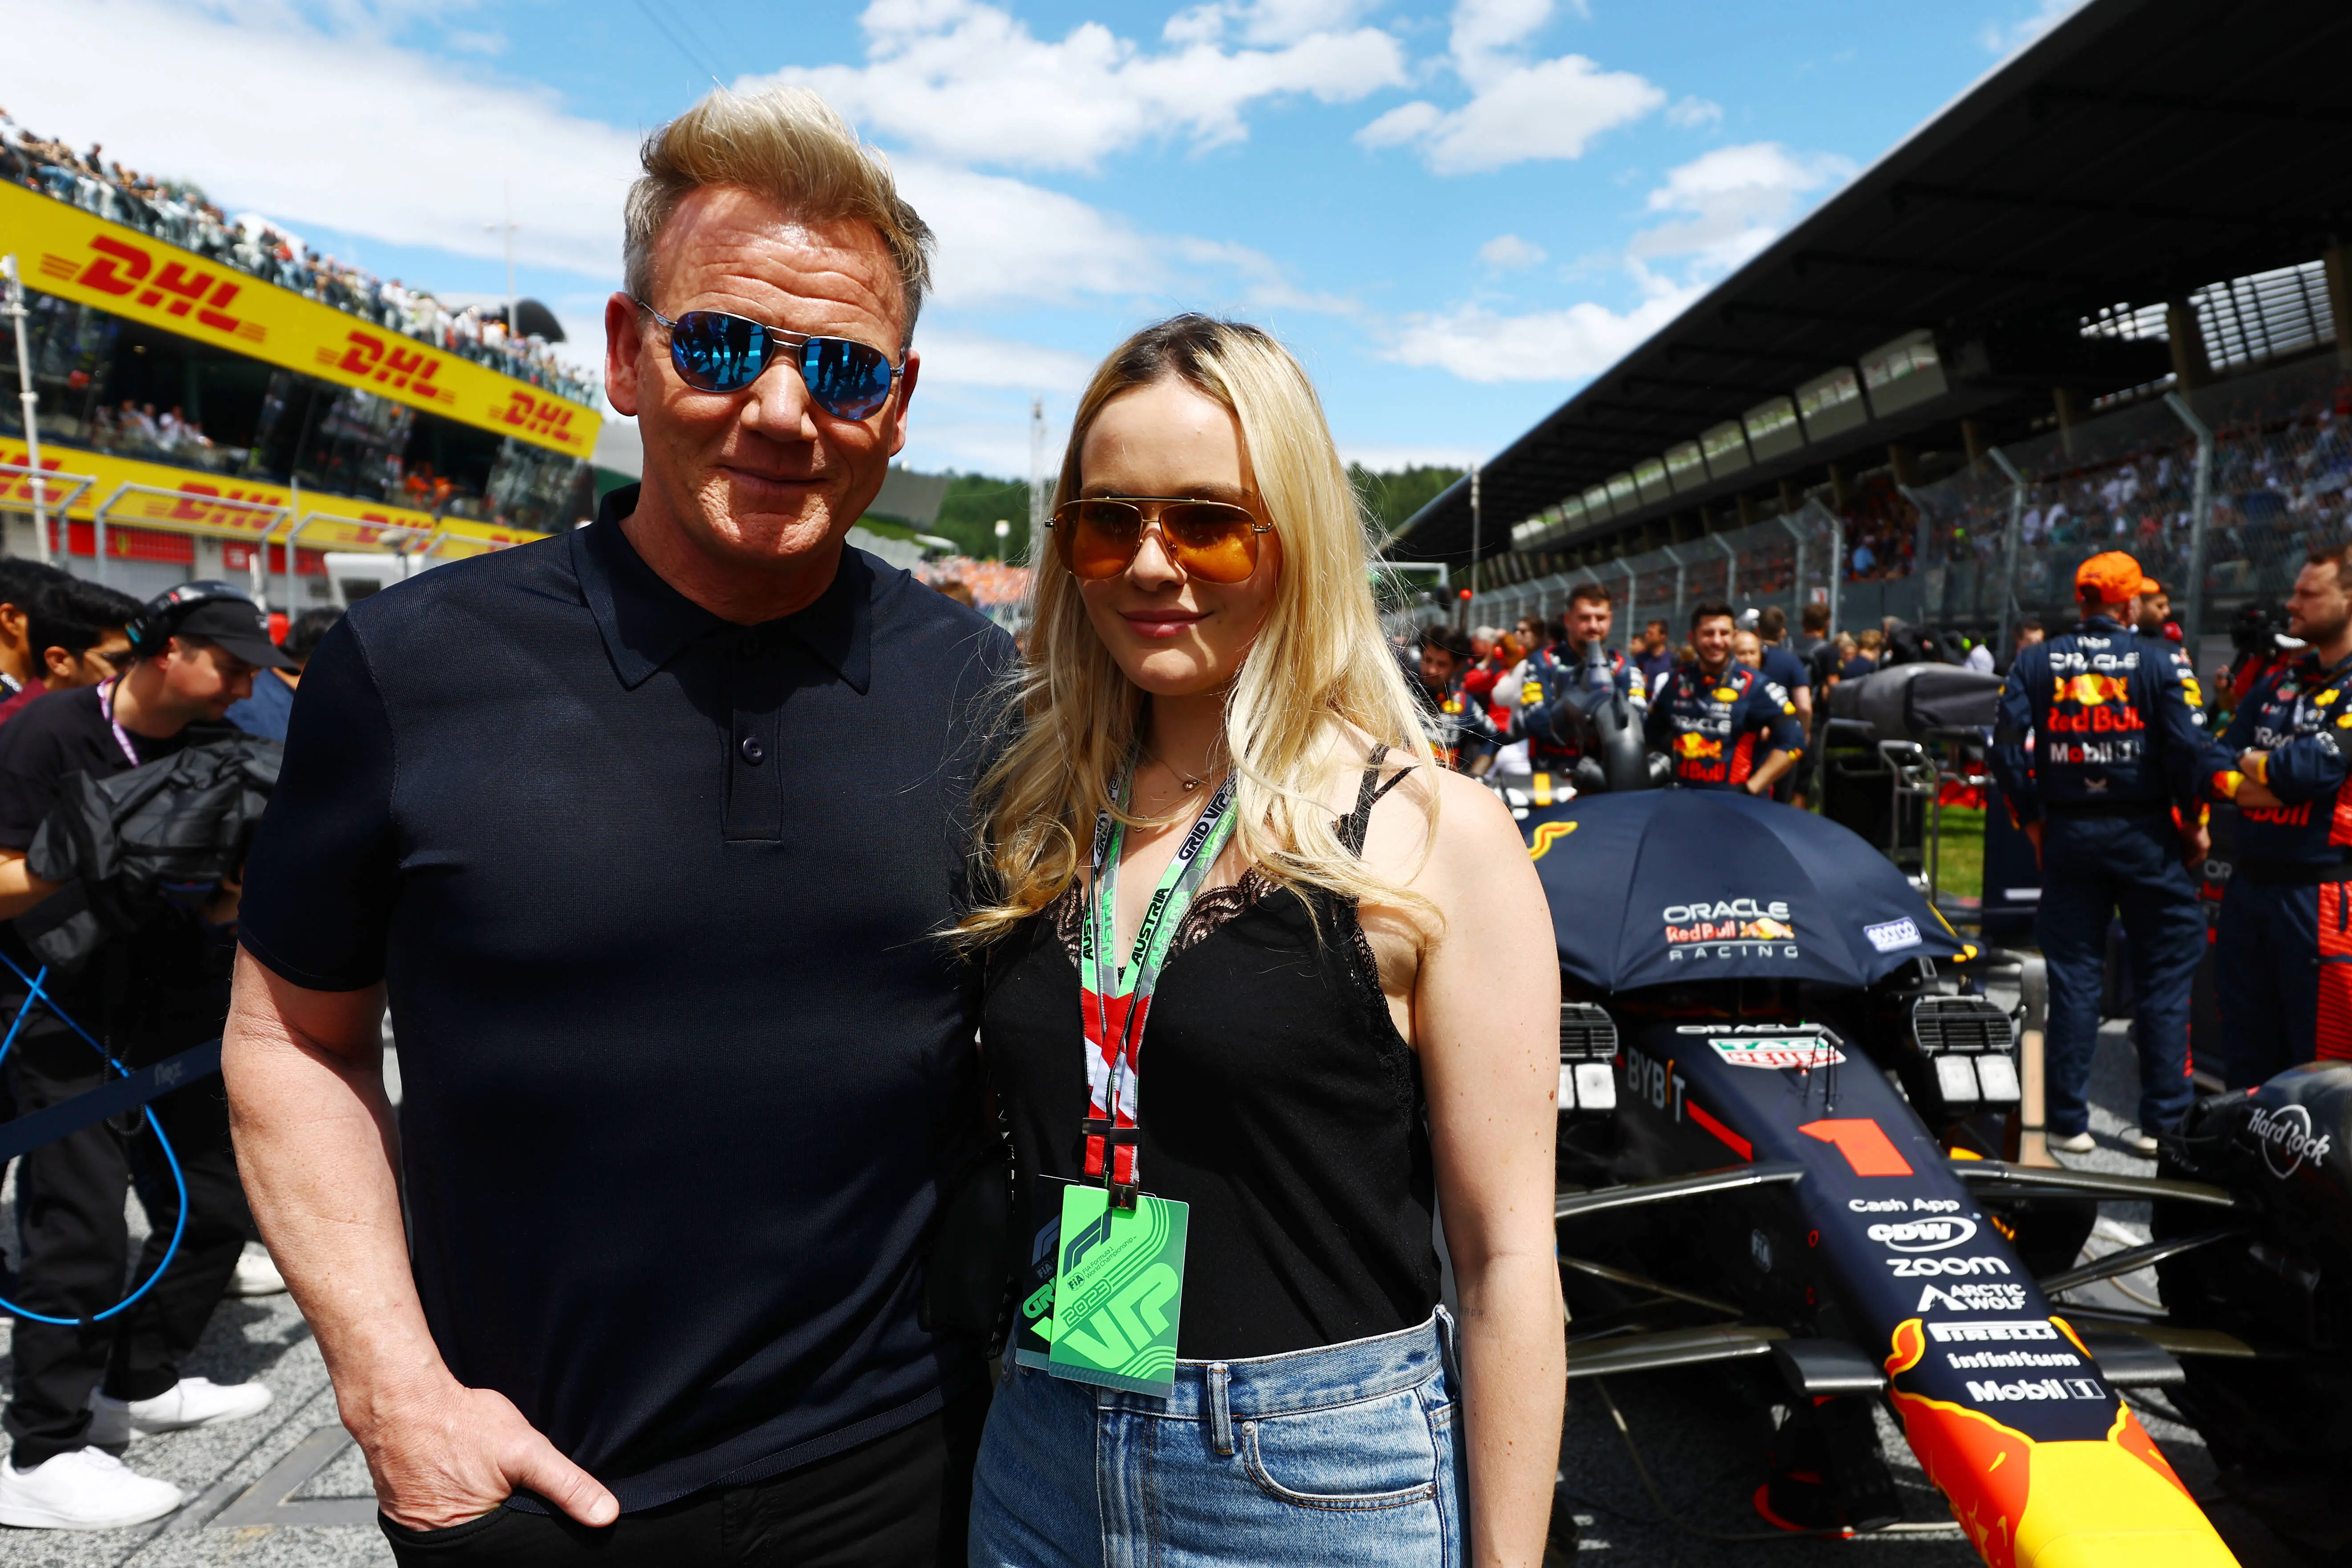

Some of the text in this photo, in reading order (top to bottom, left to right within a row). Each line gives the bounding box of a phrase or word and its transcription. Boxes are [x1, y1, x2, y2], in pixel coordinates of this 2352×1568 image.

[78, 235, 241, 333] DHL
[337, 331, 441, 397] DHL
[502, 390, 575, 442] DHL
[0, 450, 62, 502] HL
[2047, 705, 2146, 733] Red Bull
[2050, 742, 2112, 764] Mobil
[1178, 793, 1226, 860] GRID VIP
[1663, 898, 1790, 924] ORACLE
[1102, 887, 1113, 967] AUSTRIA
[1132, 888, 1170, 967] AUSTRIA
[1149, 891, 1190, 970] AUSTRIA
[1669, 945, 1798, 962] RACING
[1676, 1023, 1822, 1034] ORACLE
[1721, 1041, 1821, 1050] TAG
[1730, 1051, 1837, 1066] HEUER
[1627, 1046, 1685, 1123] BYBIT
[2247, 1107, 2293, 1145] Hard
[1797, 1118, 1915, 1177] 1
[1848, 1198, 1960, 1213] Cash App
[1867, 1223, 1951, 1242] CDW
[1082, 1263, 1092, 1274] FIA
[1090, 1248, 1111, 1267] Formula
[1085, 1237, 1133, 1279] World Championship
[1886, 1257, 2011, 1277] zoom
[1061, 1279, 1111, 1327] 2023
[1951, 1284, 2027, 1297] ARCTIC
[1965, 1297, 2026, 1310] WOLF
[1062, 1263, 1178, 1369] VIP
[1927, 1321, 2058, 1342] PIRELLI
[1947, 1350, 2081, 1369] infinitum
[1965, 1378, 2069, 1402] Mobil
